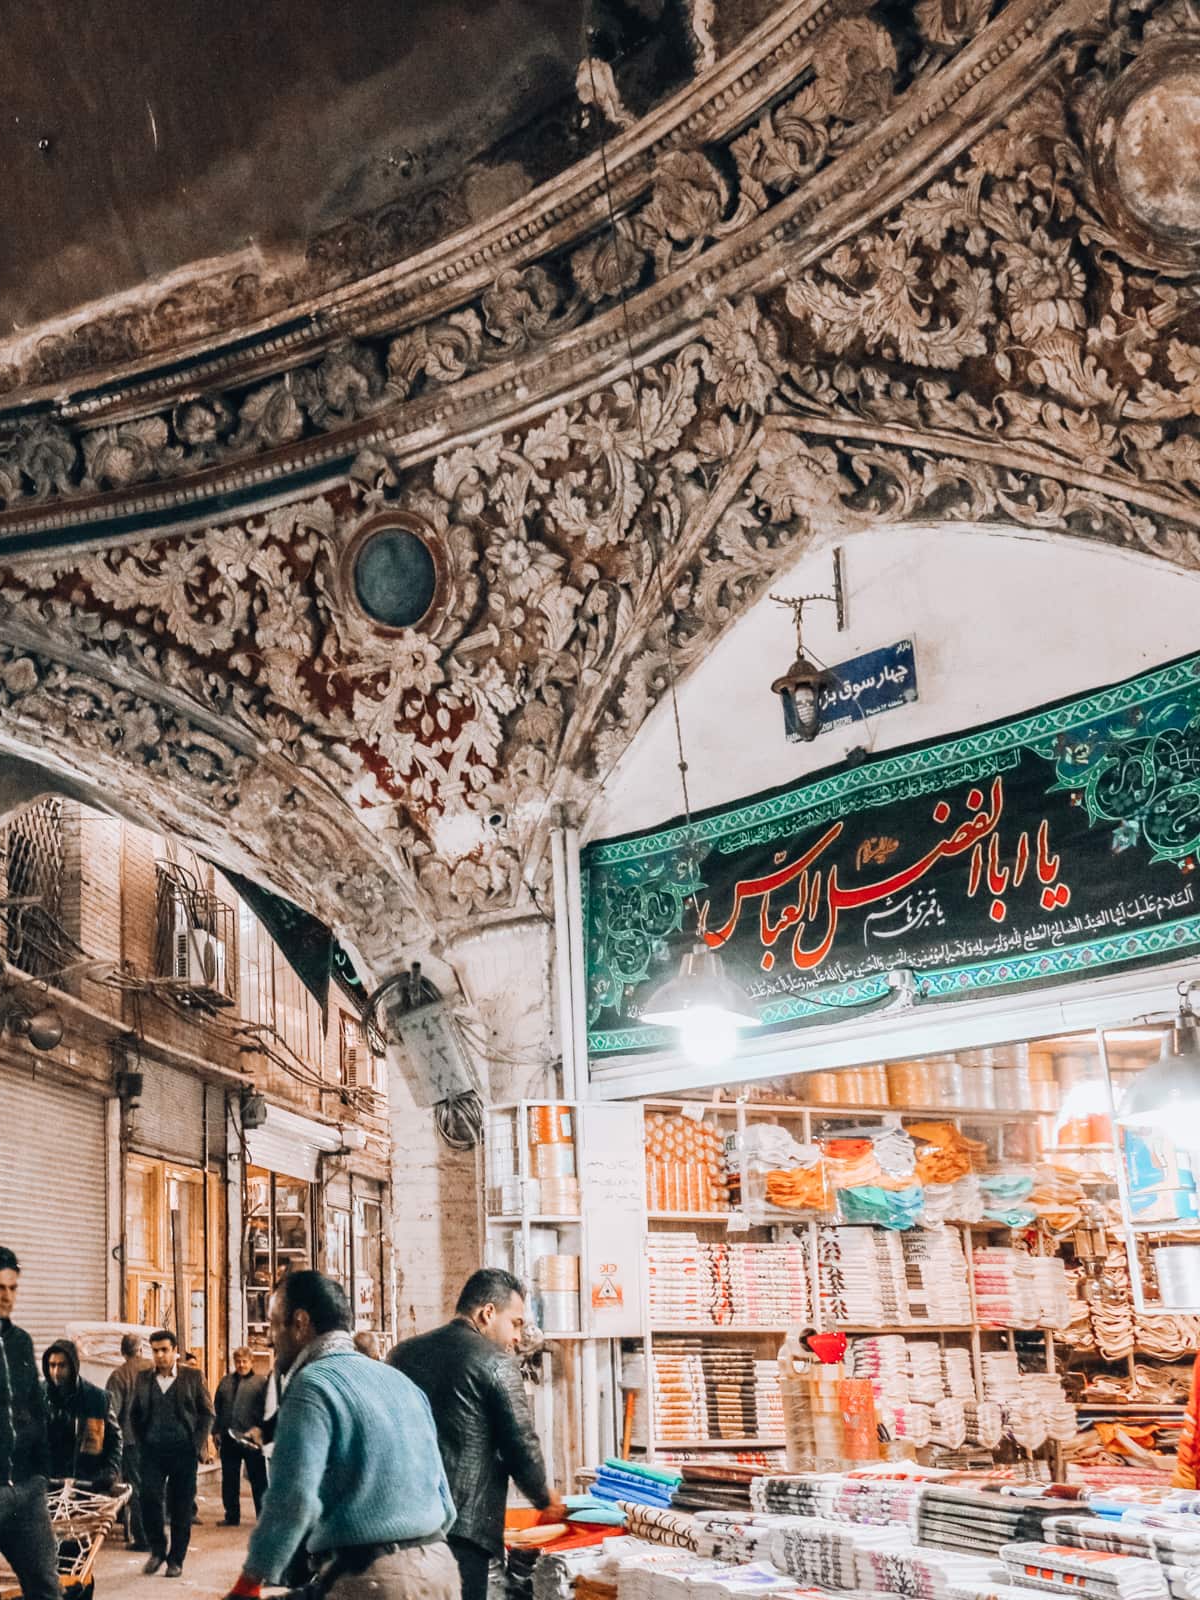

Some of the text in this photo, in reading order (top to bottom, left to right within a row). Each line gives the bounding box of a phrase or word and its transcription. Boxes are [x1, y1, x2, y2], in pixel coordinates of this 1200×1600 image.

[838, 676, 876, 702] سوق
[875, 664, 908, 689] چهار
[1036, 818, 1071, 911] یا
